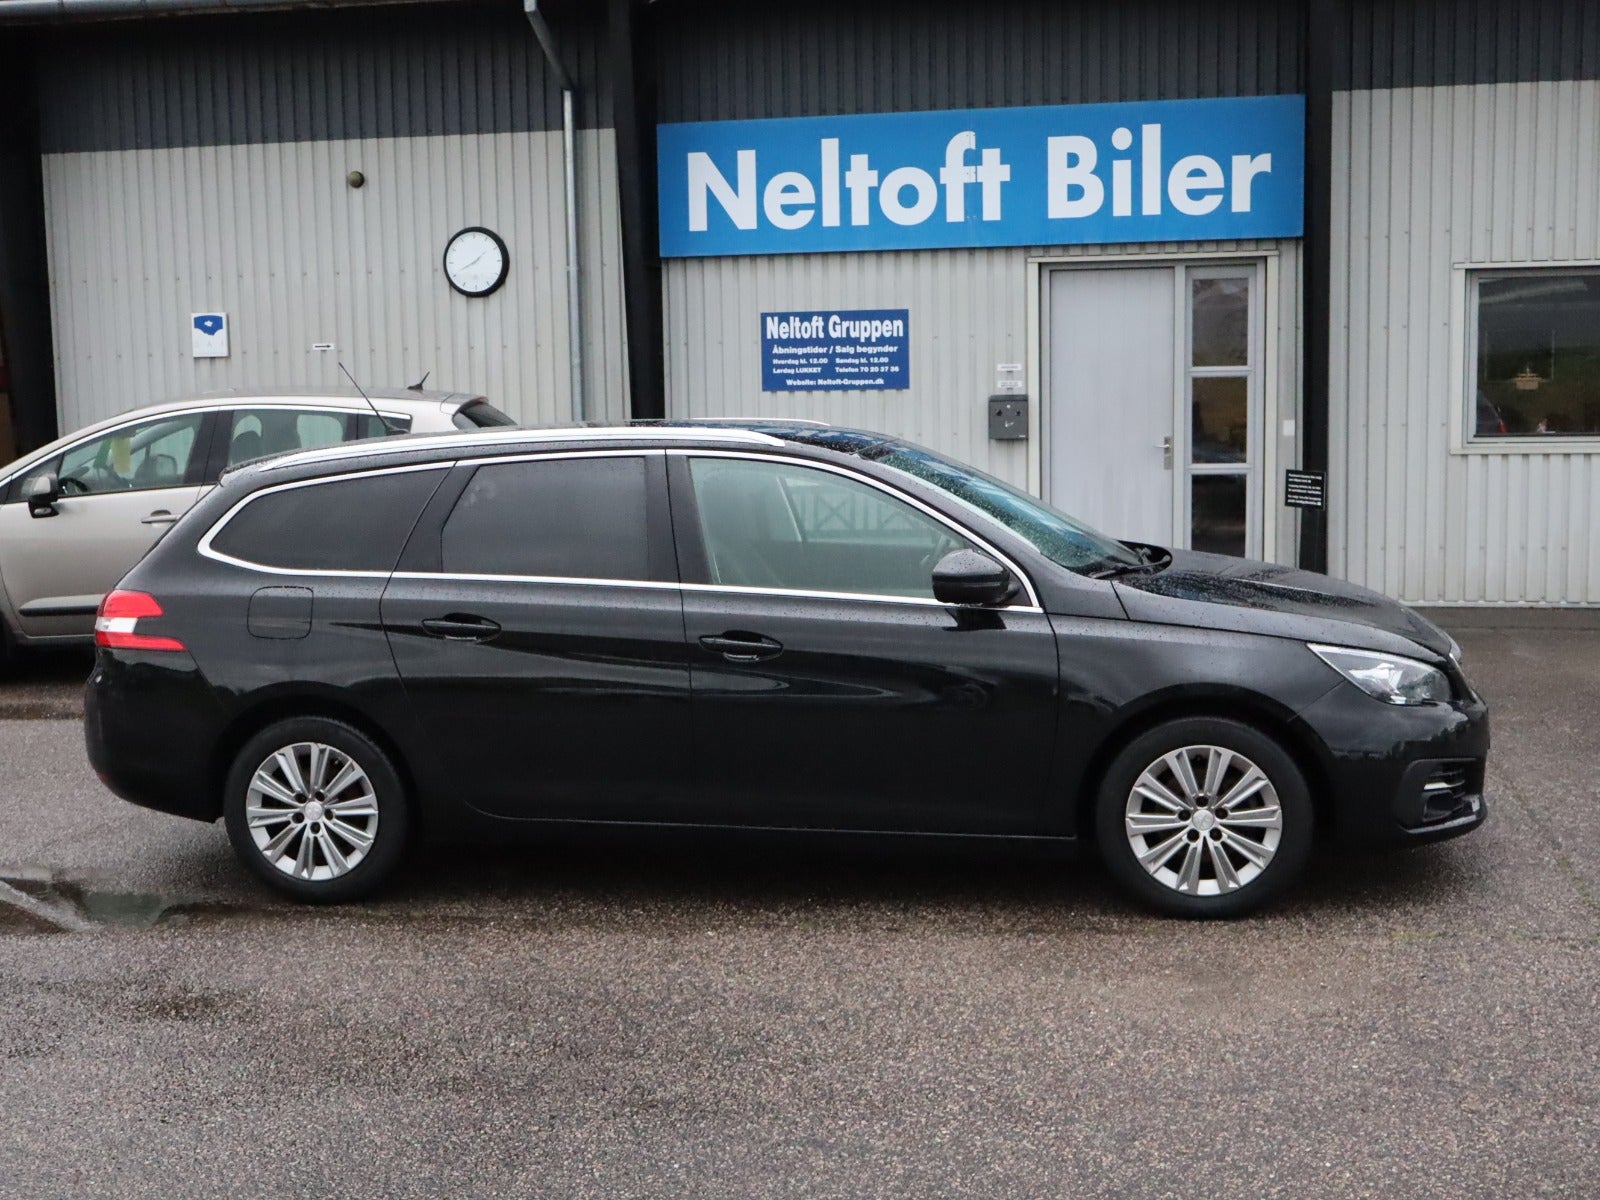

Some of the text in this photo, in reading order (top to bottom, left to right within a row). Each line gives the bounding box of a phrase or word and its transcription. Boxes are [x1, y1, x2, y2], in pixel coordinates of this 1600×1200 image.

[686, 123, 1272, 233] Neltoft Biler
[766, 314, 904, 343] Neltoft Gruppen
[772, 344, 898, 355] Åbningstider / Salg begynder
[817, 378, 885, 386] Neltoft-Gruppen.dk
